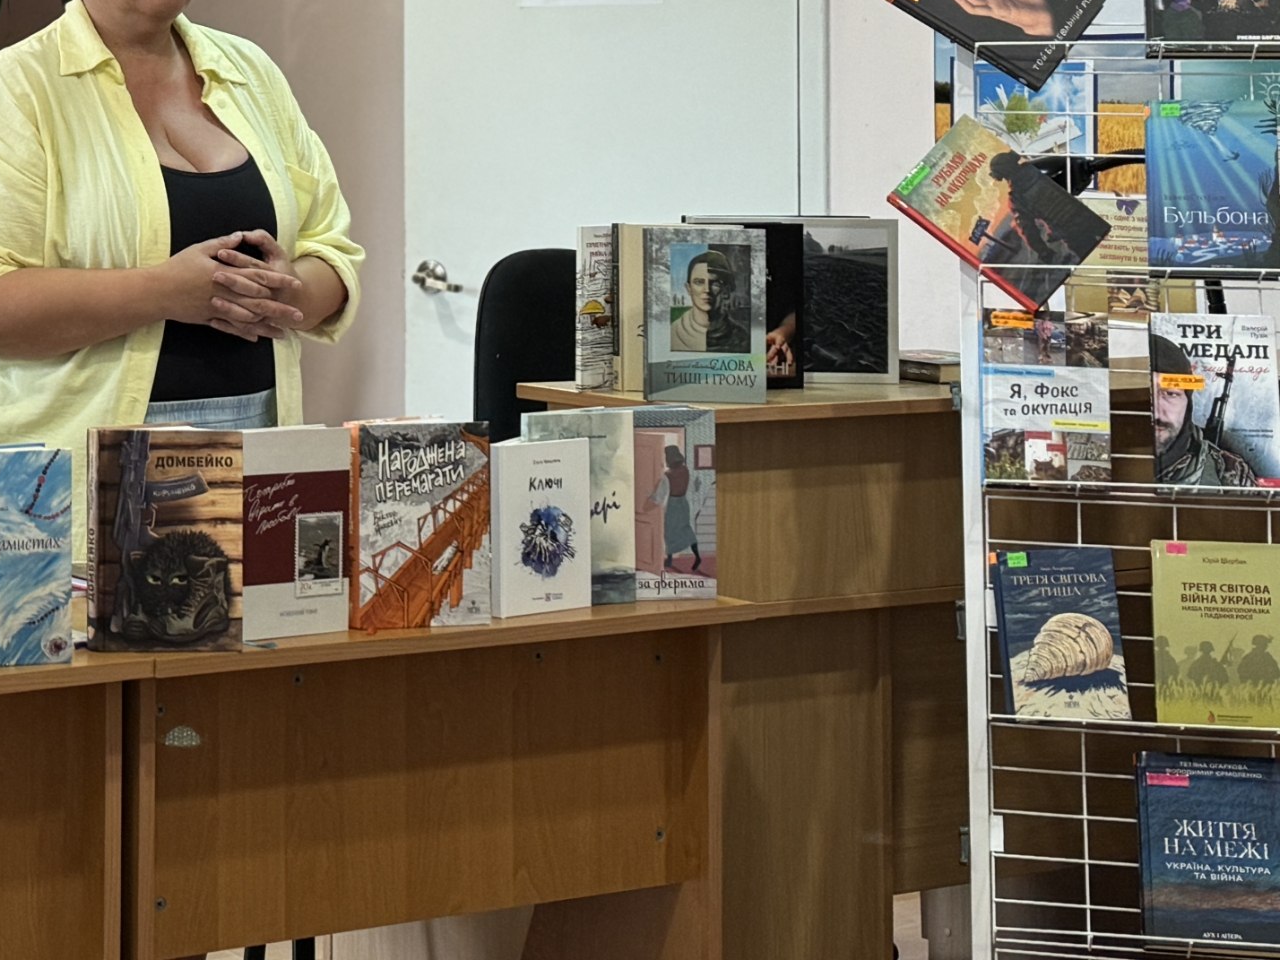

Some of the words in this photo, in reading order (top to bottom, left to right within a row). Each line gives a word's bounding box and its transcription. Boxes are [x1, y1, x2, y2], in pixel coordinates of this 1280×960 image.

[1164, 207, 1269, 228] Бульбона
[1177, 324, 1222, 339] ТРИ
[1179, 343, 1269, 361] МЕДАЛІ
[1009, 383, 1027, 401] Я,
[1003, 408, 1016, 416] та
[1021, 403, 1092, 417] ОКУПАЦІЯ
[155, 453, 233, 469] ДОМБЕЙКО
[638, 580, 651, 589] за
[654, 571, 705, 595] дверима
[1011, 575, 1048, 585] ТРЕТЯ
[1050, 573, 1107, 584] СВІТОВА
[1040, 586, 1081, 597] ТИША
[1181, 582, 1217, 593] ТРЕТЯ
[1220, 583, 1270, 595] СВІТОВА
[1181, 592, 1218, 605] ВІЙНА
[1220, 594, 1272, 607] УКРАЇНИ
[1174, 819, 1257, 840] ЖИТТЯ
[1164, 837, 1197, 856] НА
[1204, 839, 1269, 860] МЕЖІ
[1166, 862, 1215, 873] УКРАЇНА,
[1218, 865, 1271, 875] КУЛЬТУРА
[1194, 872, 1206, 880] ТА
[1210, 872, 1243, 882] ВІЙНА
